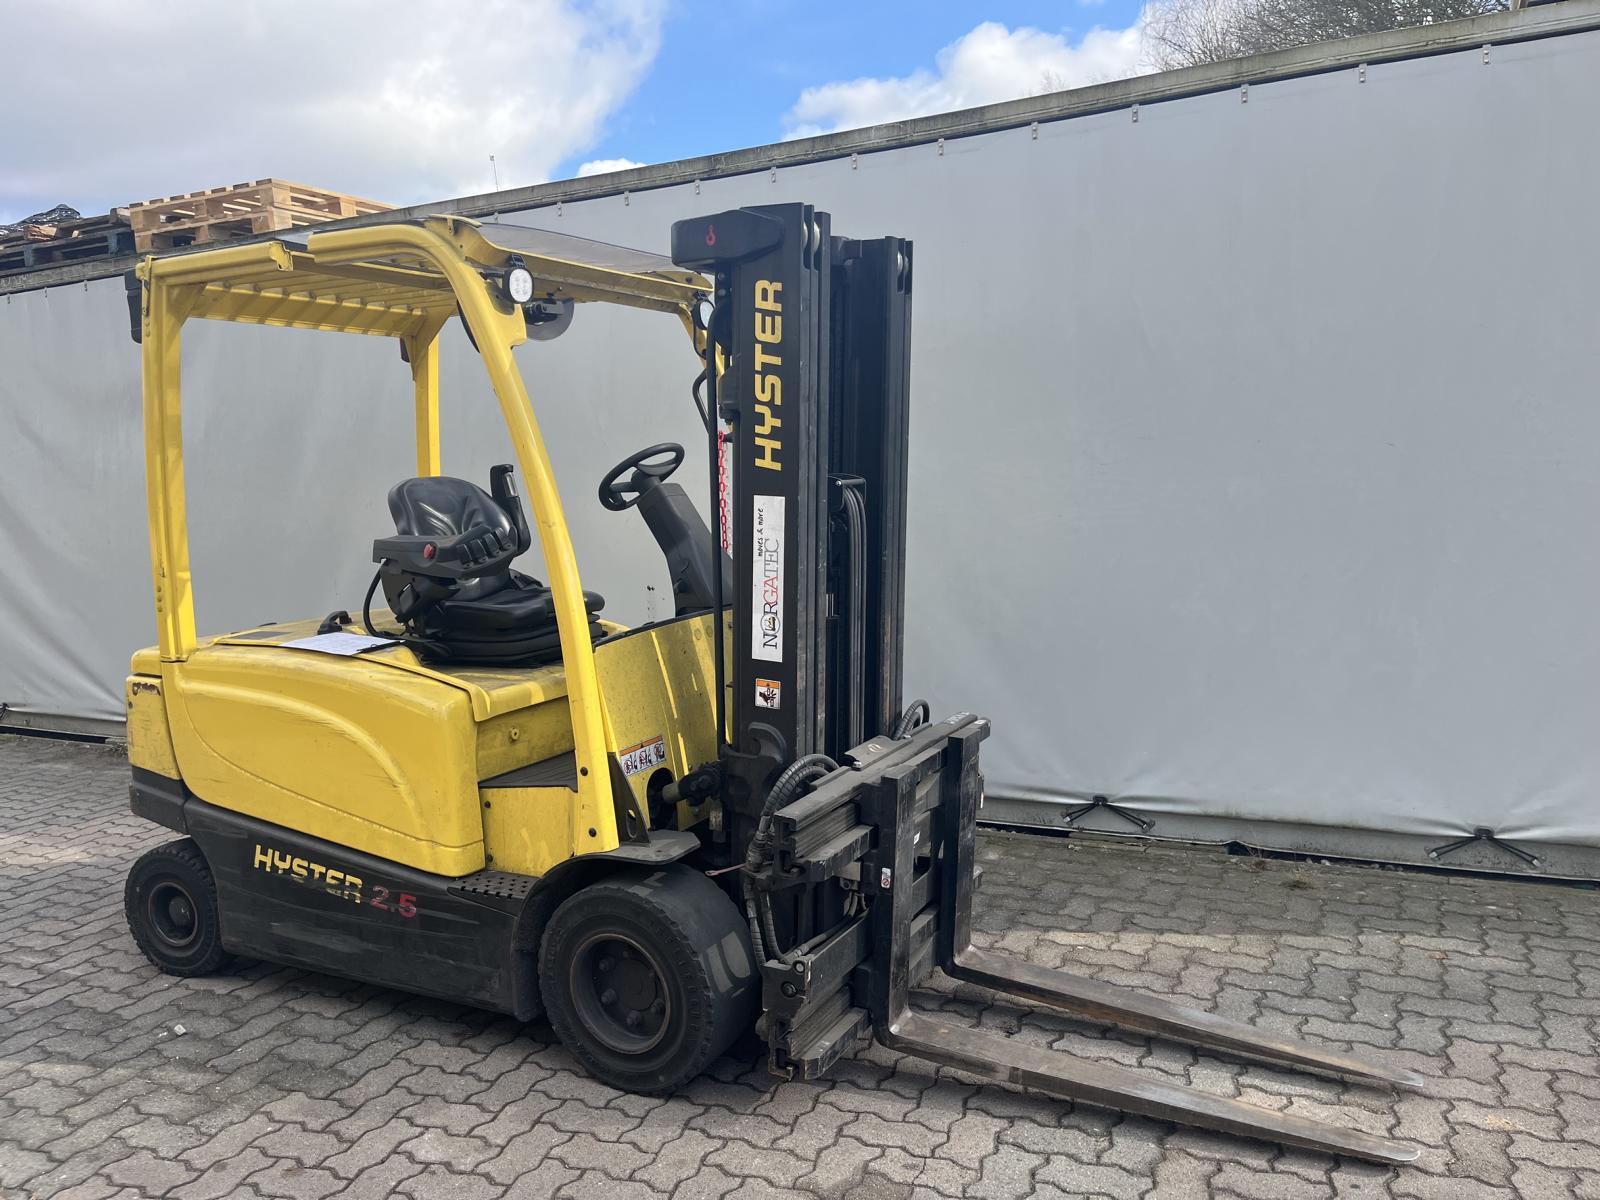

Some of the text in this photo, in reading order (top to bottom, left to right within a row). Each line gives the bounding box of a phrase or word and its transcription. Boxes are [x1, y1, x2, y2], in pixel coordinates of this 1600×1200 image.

[754, 279, 783, 471] HYSTER
[760, 538, 781, 650] NORGATEC
[253, 843, 364, 904] HYSTER
